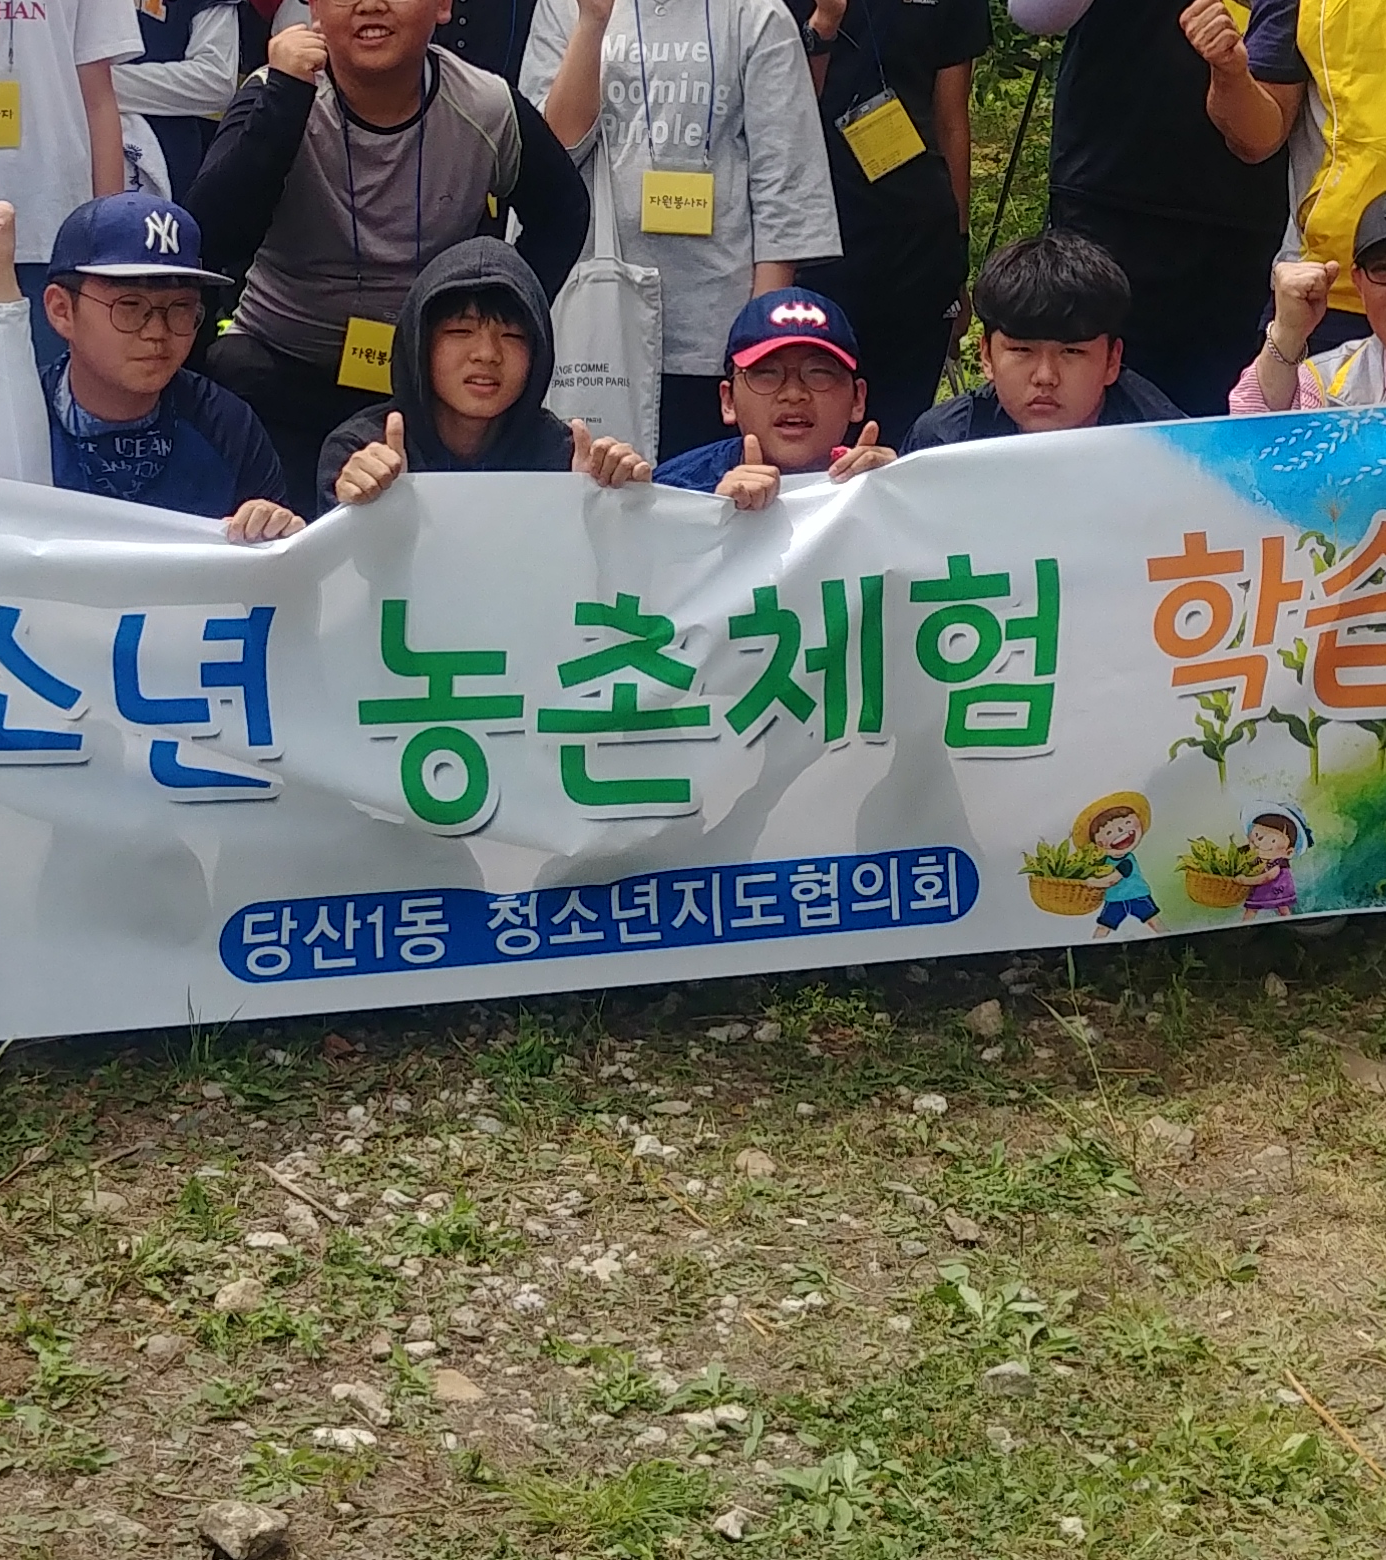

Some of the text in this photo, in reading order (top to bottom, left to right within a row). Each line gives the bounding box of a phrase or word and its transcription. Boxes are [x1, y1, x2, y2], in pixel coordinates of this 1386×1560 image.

[601, 34, 709, 63] Mauve
[607, 72, 731, 115] ooming
[649, 194, 709, 211] 자원봉사자
[144, 210, 180, 254] NY
[351, 346, 392, 367] 자원봉
[574, 362, 610, 374] COMME
[576, 376, 604, 387] POUR
[605, 376, 630, 388] PARIS
[357, 554, 1060, 826] 농촌체험
[242, 852, 961, 975] 당산1동 청소년지도협의회
